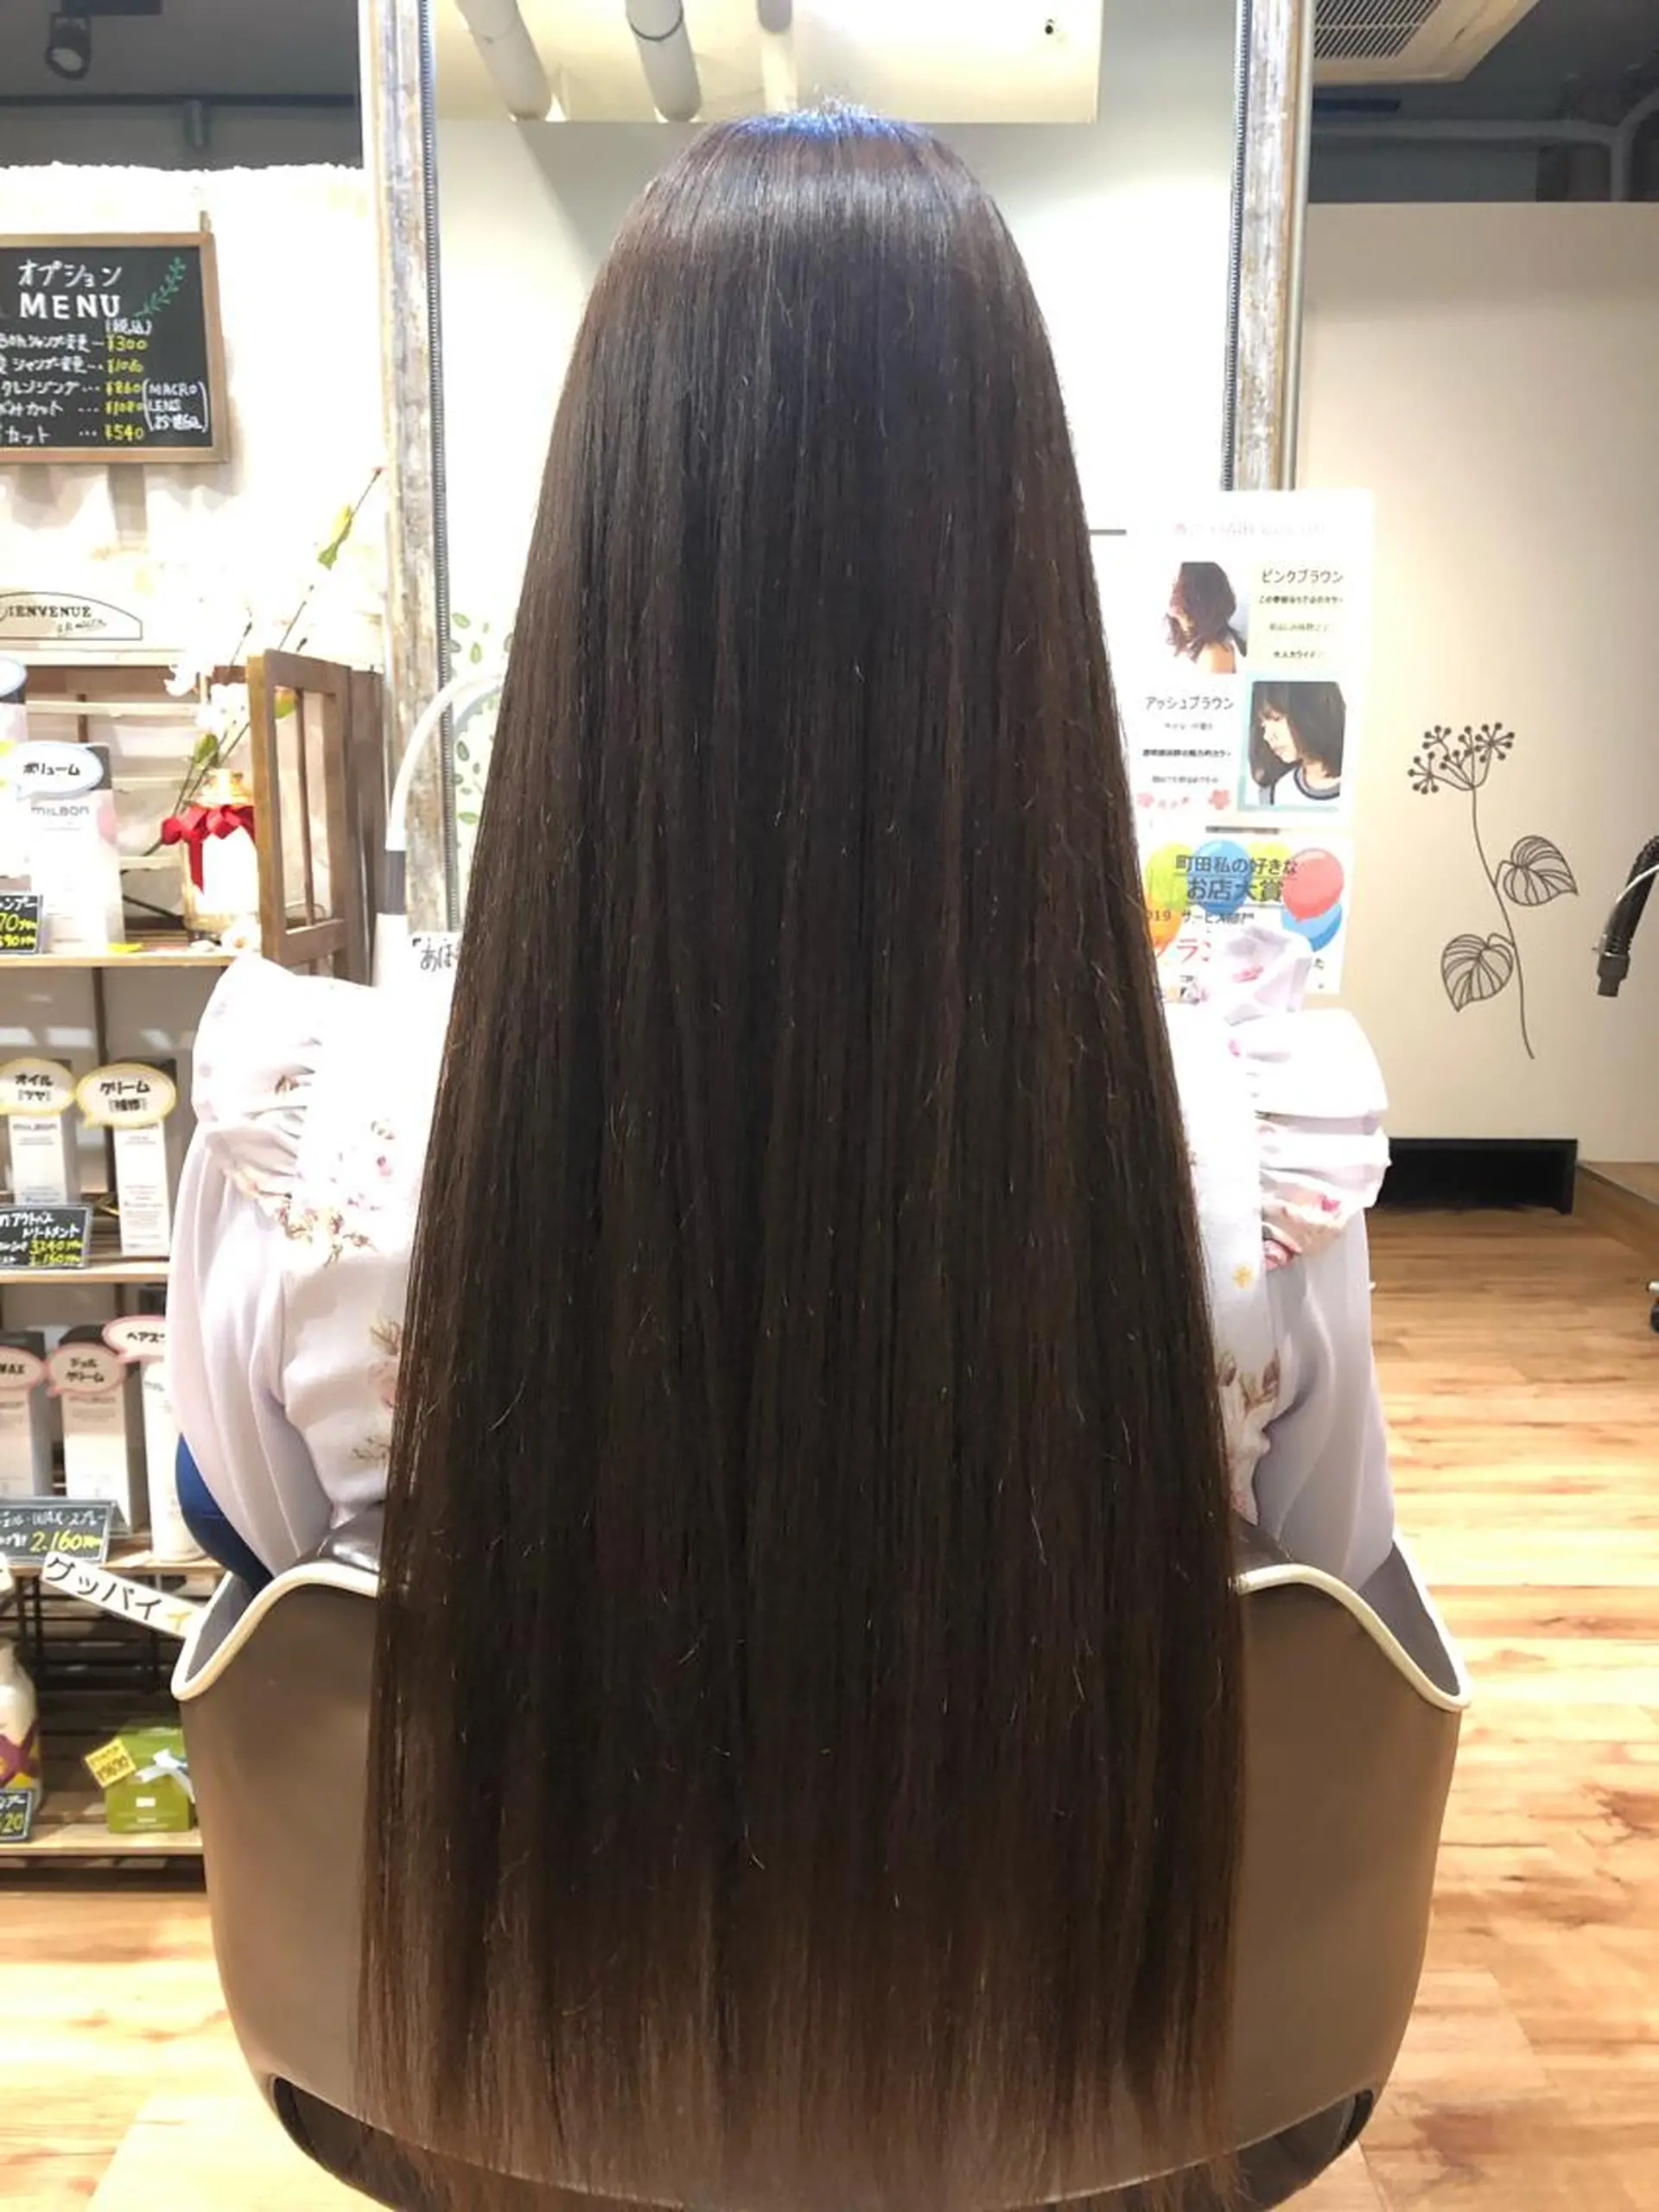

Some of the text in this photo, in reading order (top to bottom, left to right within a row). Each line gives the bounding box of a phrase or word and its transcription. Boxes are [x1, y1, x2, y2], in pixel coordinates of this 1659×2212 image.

[18, 259, 122, 288] オプション
[19, 292, 121, 319] MENU
[1261, 569, 1344, 583] ピンクブラウン
[1145, 696, 1235, 710] アッシュブラウン
[1175, 854, 1298, 875] 町田私の好きな
[1186, 876, 1284, 903] お店大賞
[16, 1074, 54, 1086] オイル
